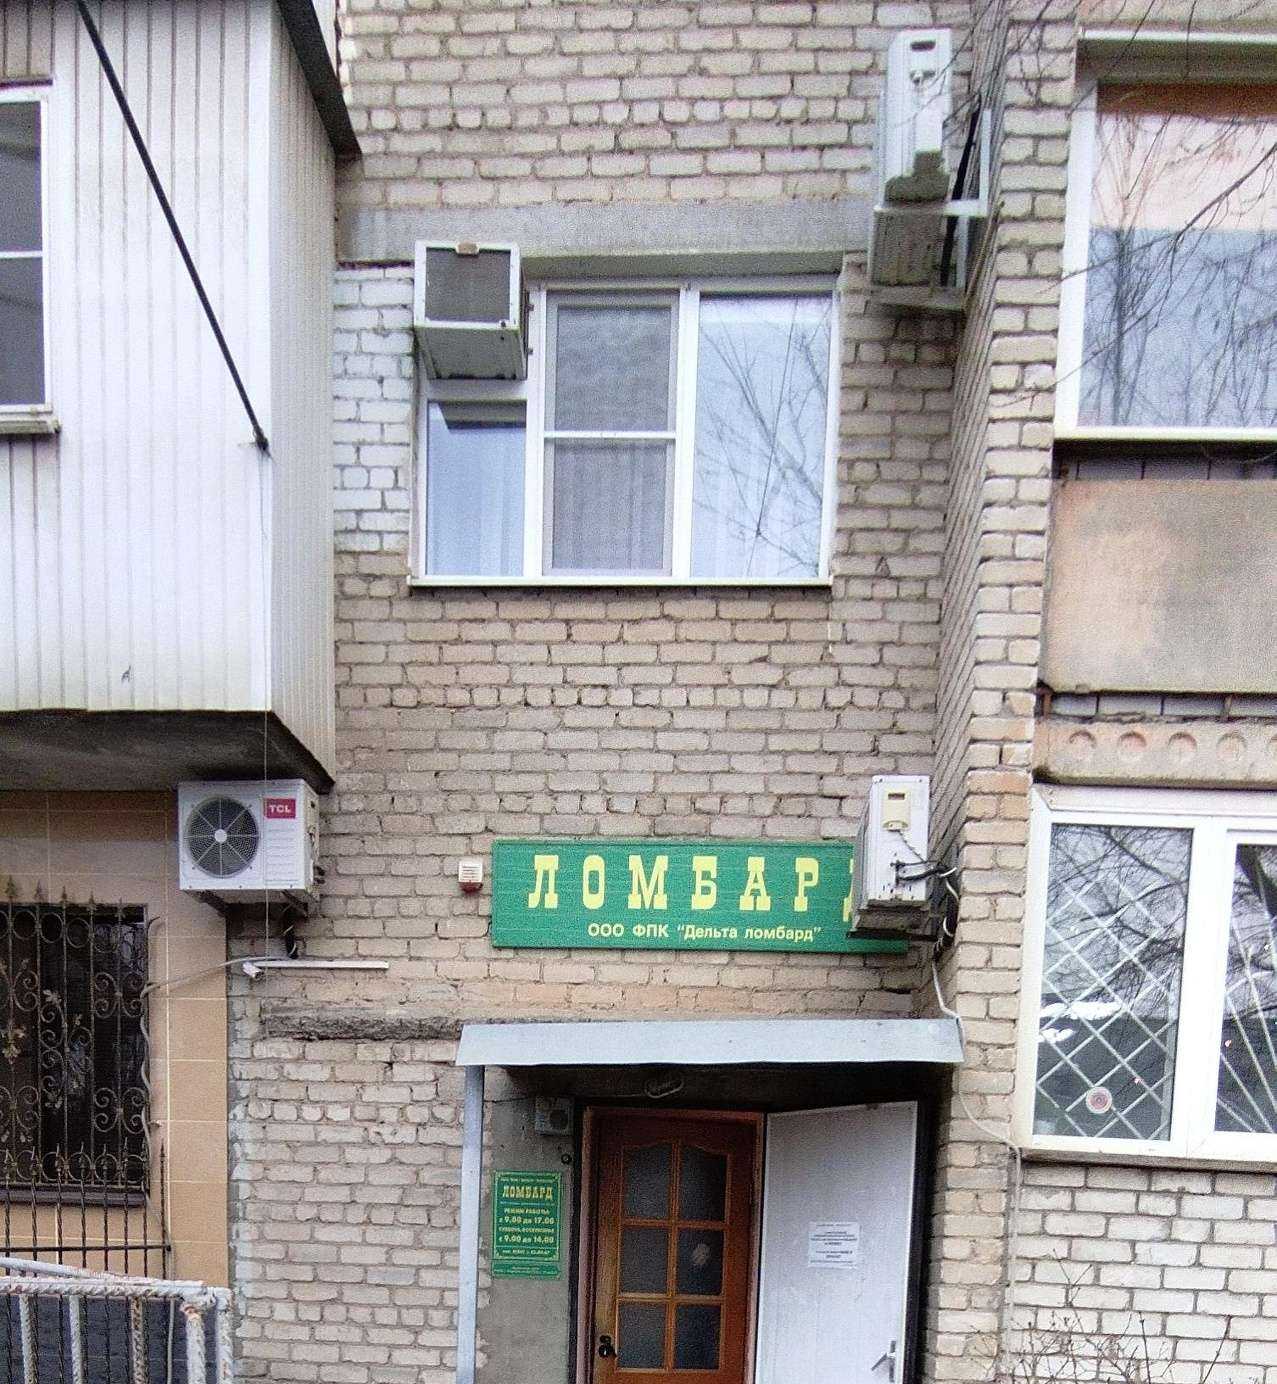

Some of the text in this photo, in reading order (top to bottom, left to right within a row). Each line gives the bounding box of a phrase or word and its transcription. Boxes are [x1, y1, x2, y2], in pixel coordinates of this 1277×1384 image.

[269, 804, 291, 813] TCL
[528, 854, 854, 922] ЛОМБАР
[587, 923, 625, 937] ООО
[632, 923, 669, 938] ФПК
[502, 1185, 553, 1200] ЛОМБАРД
